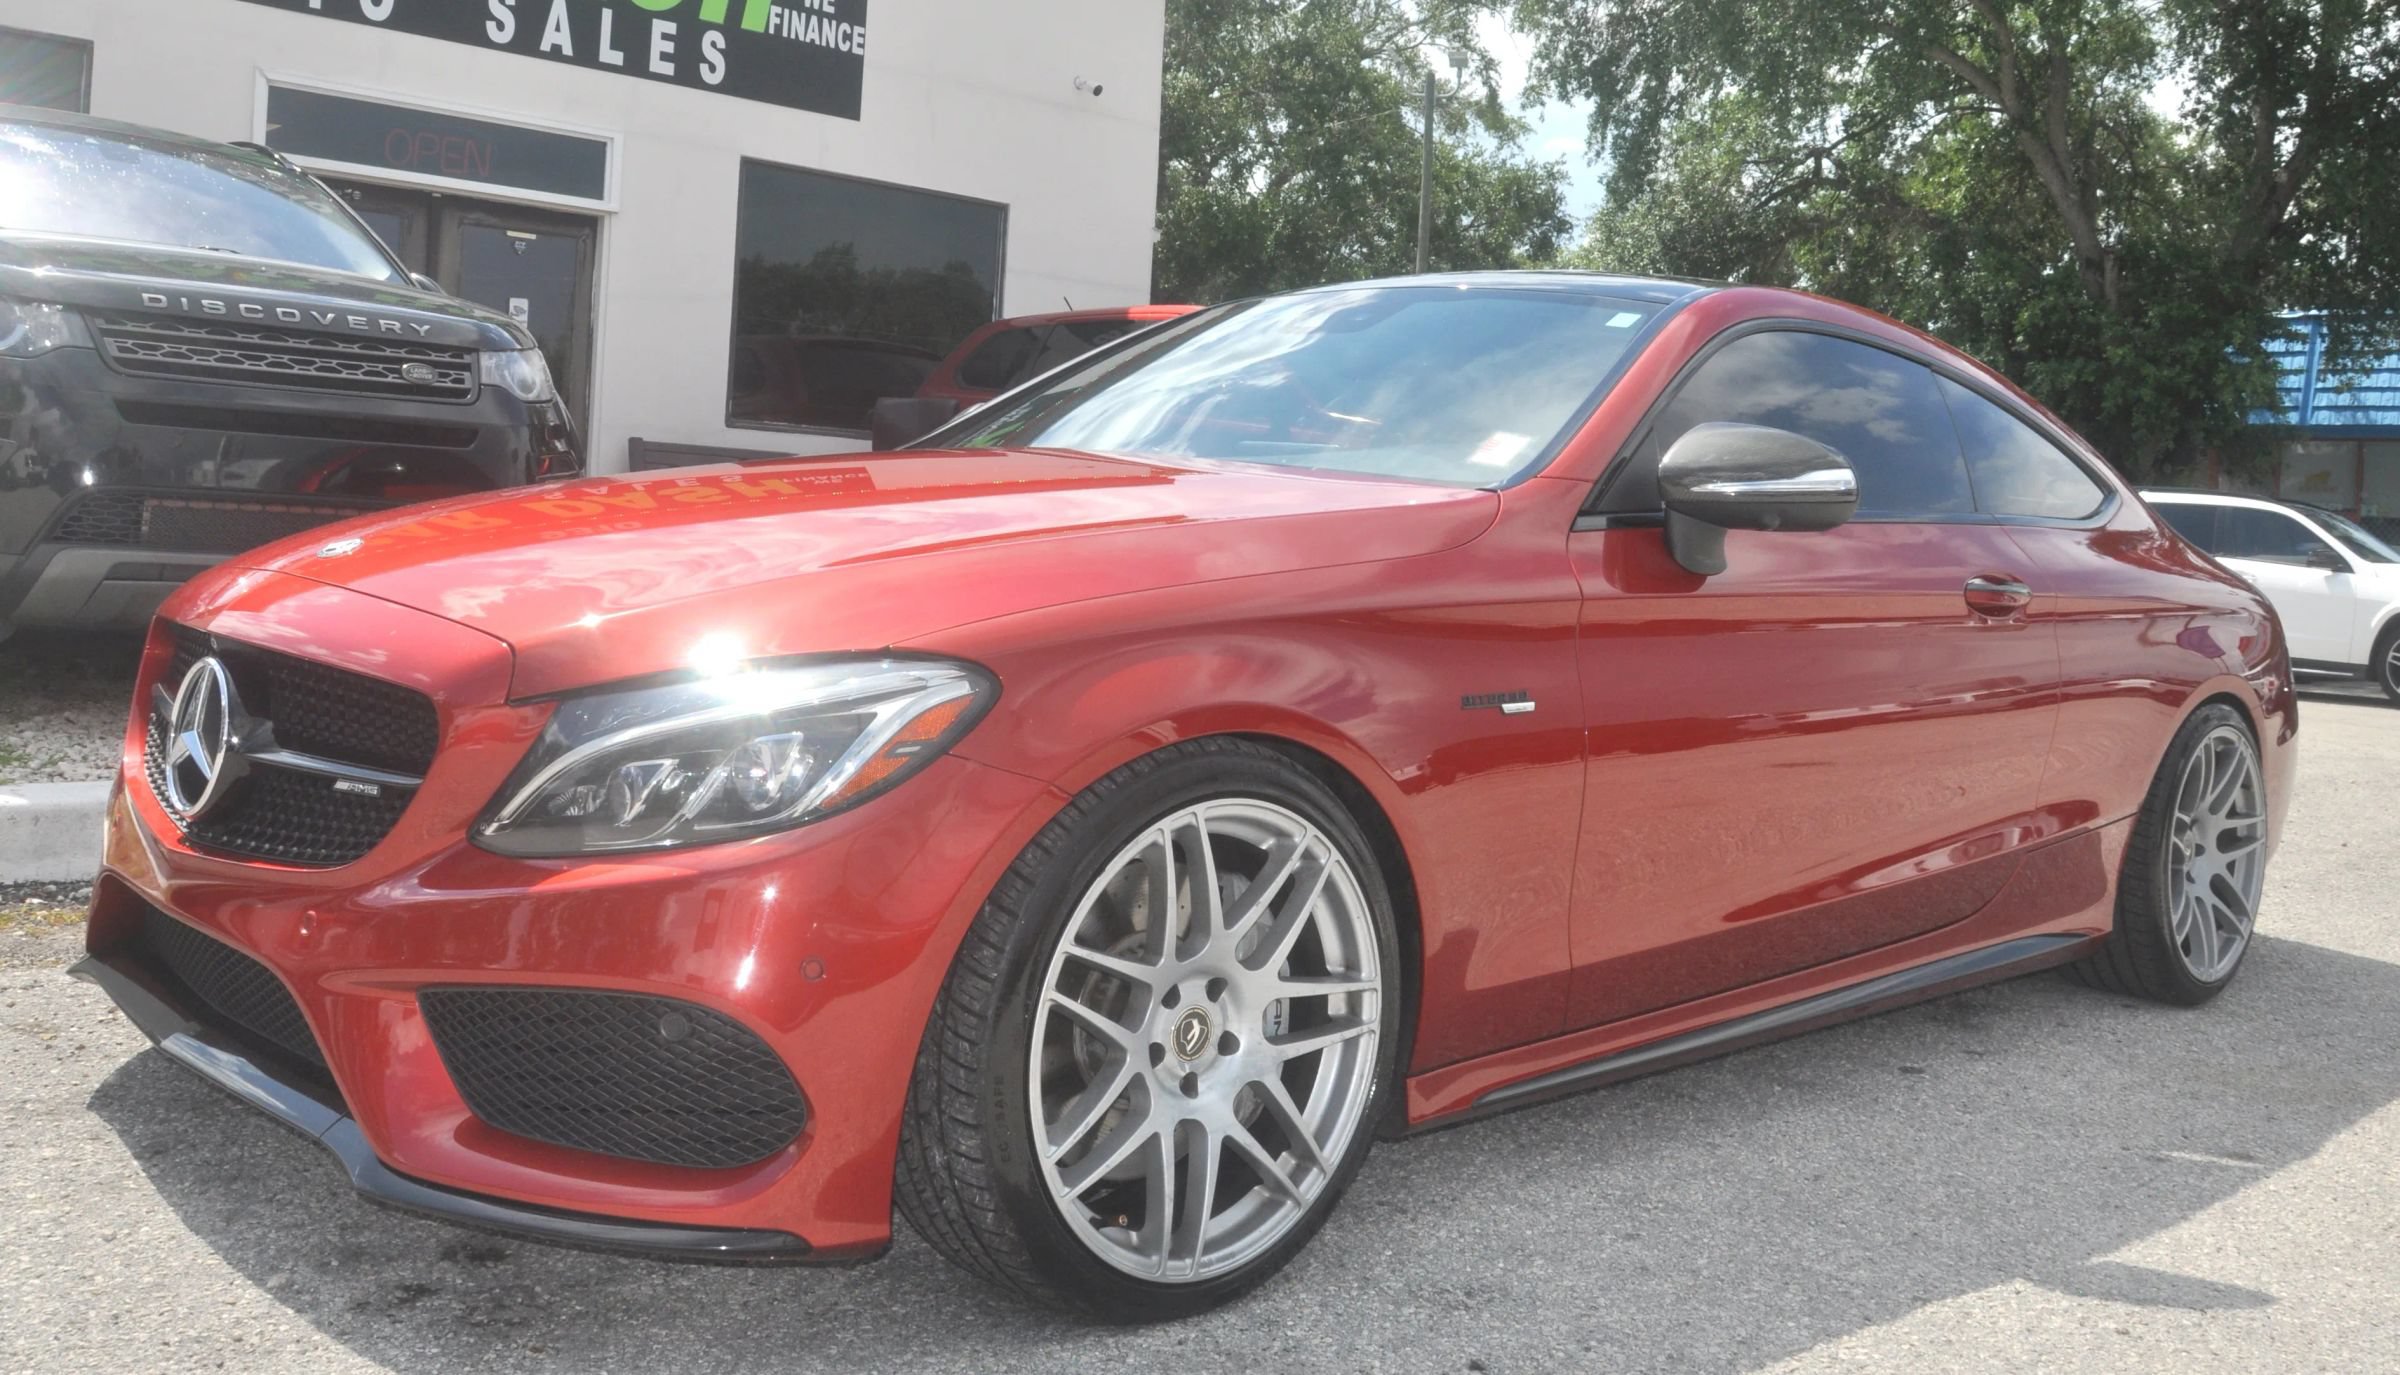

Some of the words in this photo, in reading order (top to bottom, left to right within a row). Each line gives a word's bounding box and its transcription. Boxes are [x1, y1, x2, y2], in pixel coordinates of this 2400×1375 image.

[485, 0, 726, 85] SALES
[768, 5, 866, 56] FINANCE
[383, 127, 493, 177] OPEN
[141, 293, 432, 337] DISCOVERY
